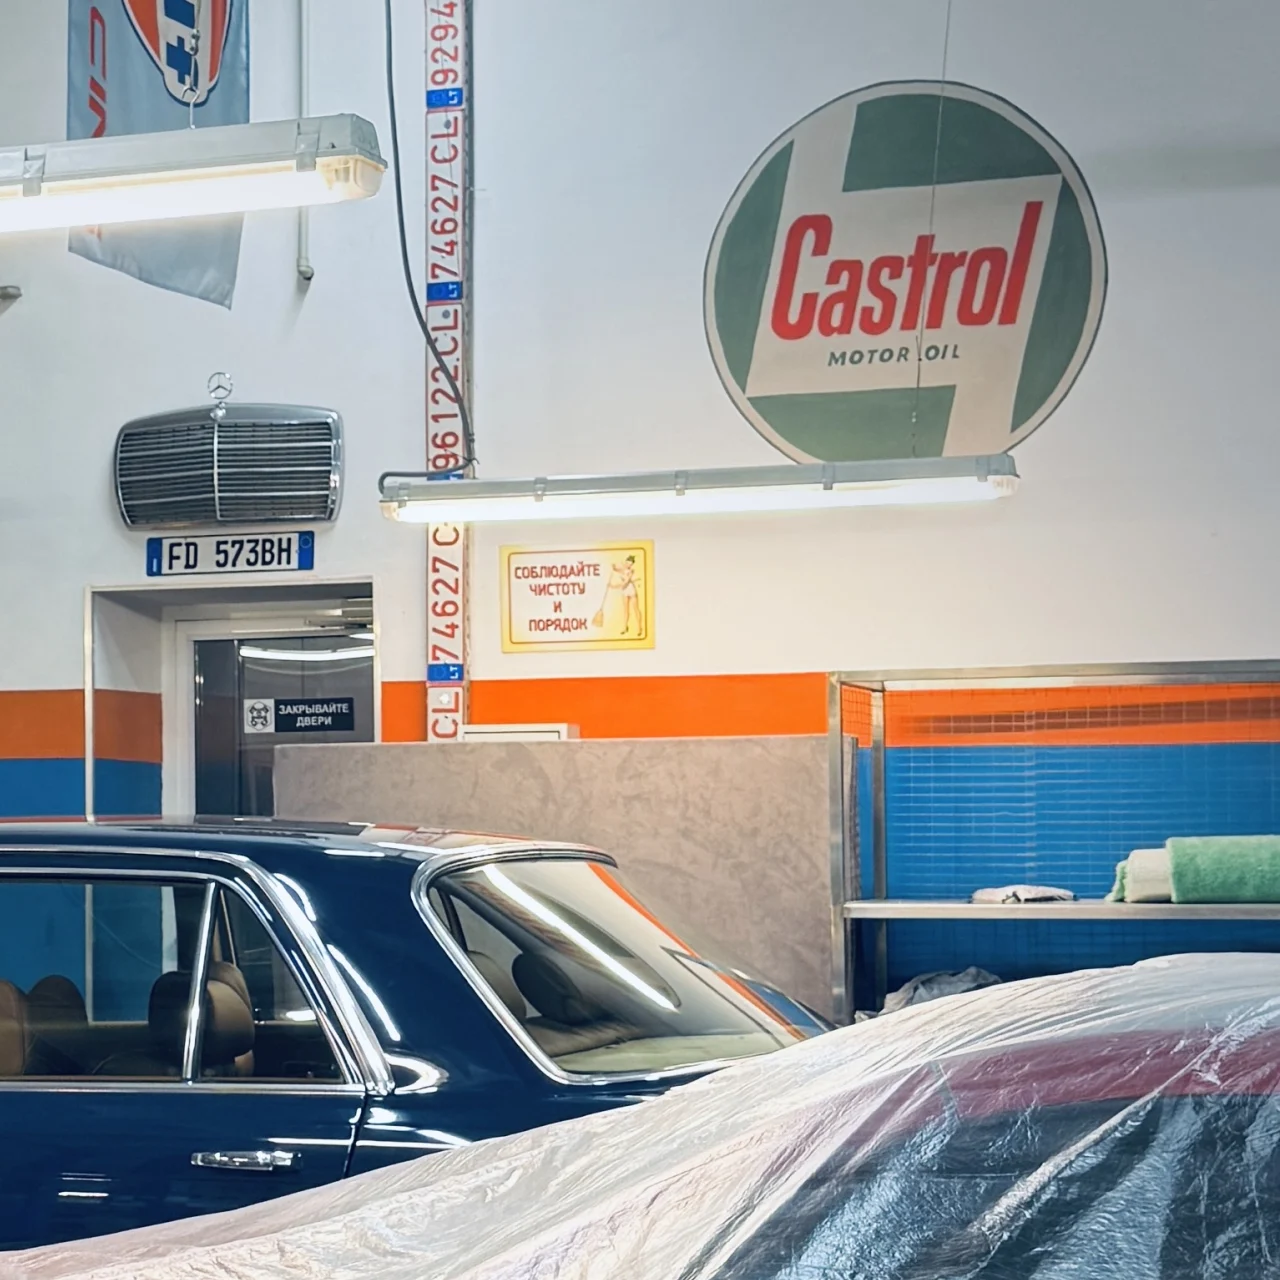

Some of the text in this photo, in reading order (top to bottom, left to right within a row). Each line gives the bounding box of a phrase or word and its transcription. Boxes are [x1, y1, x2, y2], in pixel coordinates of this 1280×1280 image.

[430, 116, 459, 164] CL
[430, 174, 459, 280] 74627
[771, 201, 1043, 341] Castrol
[431, 308, 459, 356] CL
[827, 343, 960, 367] MOTOR OIL
[431, 364, 459, 471] 96122
[168, 541, 198, 570] FD
[215, 537, 292, 568] 573BH
[514, 561, 601, 579] СОБЛЮДАЙТЕ
[529, 582, 586, 596] ЧИСТОТУ
[431, 556, 460, 662] 74627
[553, 601, 563, 613] И
[528, 617, 588, 633] ПОРЯДОК
[278, 702, 350, 715] ЗАКРЫВАЙТЕ
[295, 715, 332, 728] ДВЕРИ
[431, 691, 460, 739] CL
